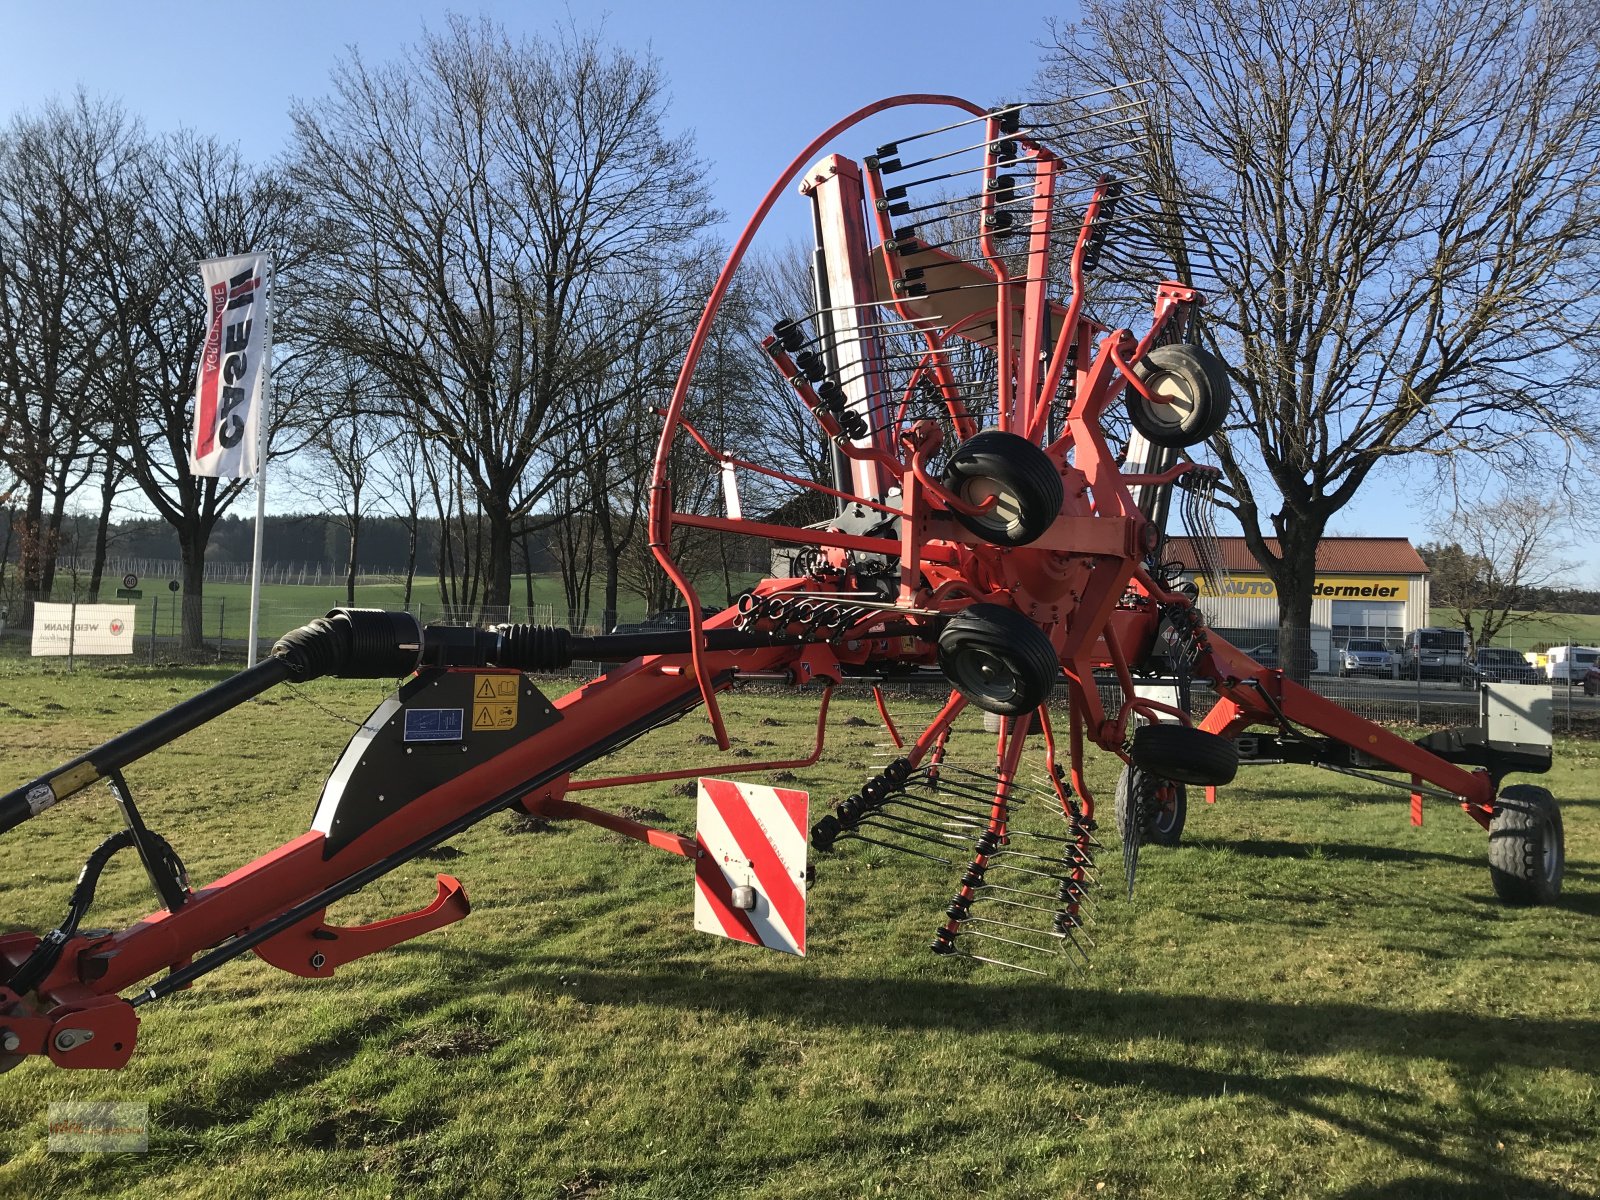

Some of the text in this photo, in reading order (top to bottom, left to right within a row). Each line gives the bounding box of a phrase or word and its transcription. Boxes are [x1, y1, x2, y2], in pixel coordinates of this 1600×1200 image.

[126, 577, 135, 586] 60
[1222, 581, 1399, 597] AUTO dermeier
